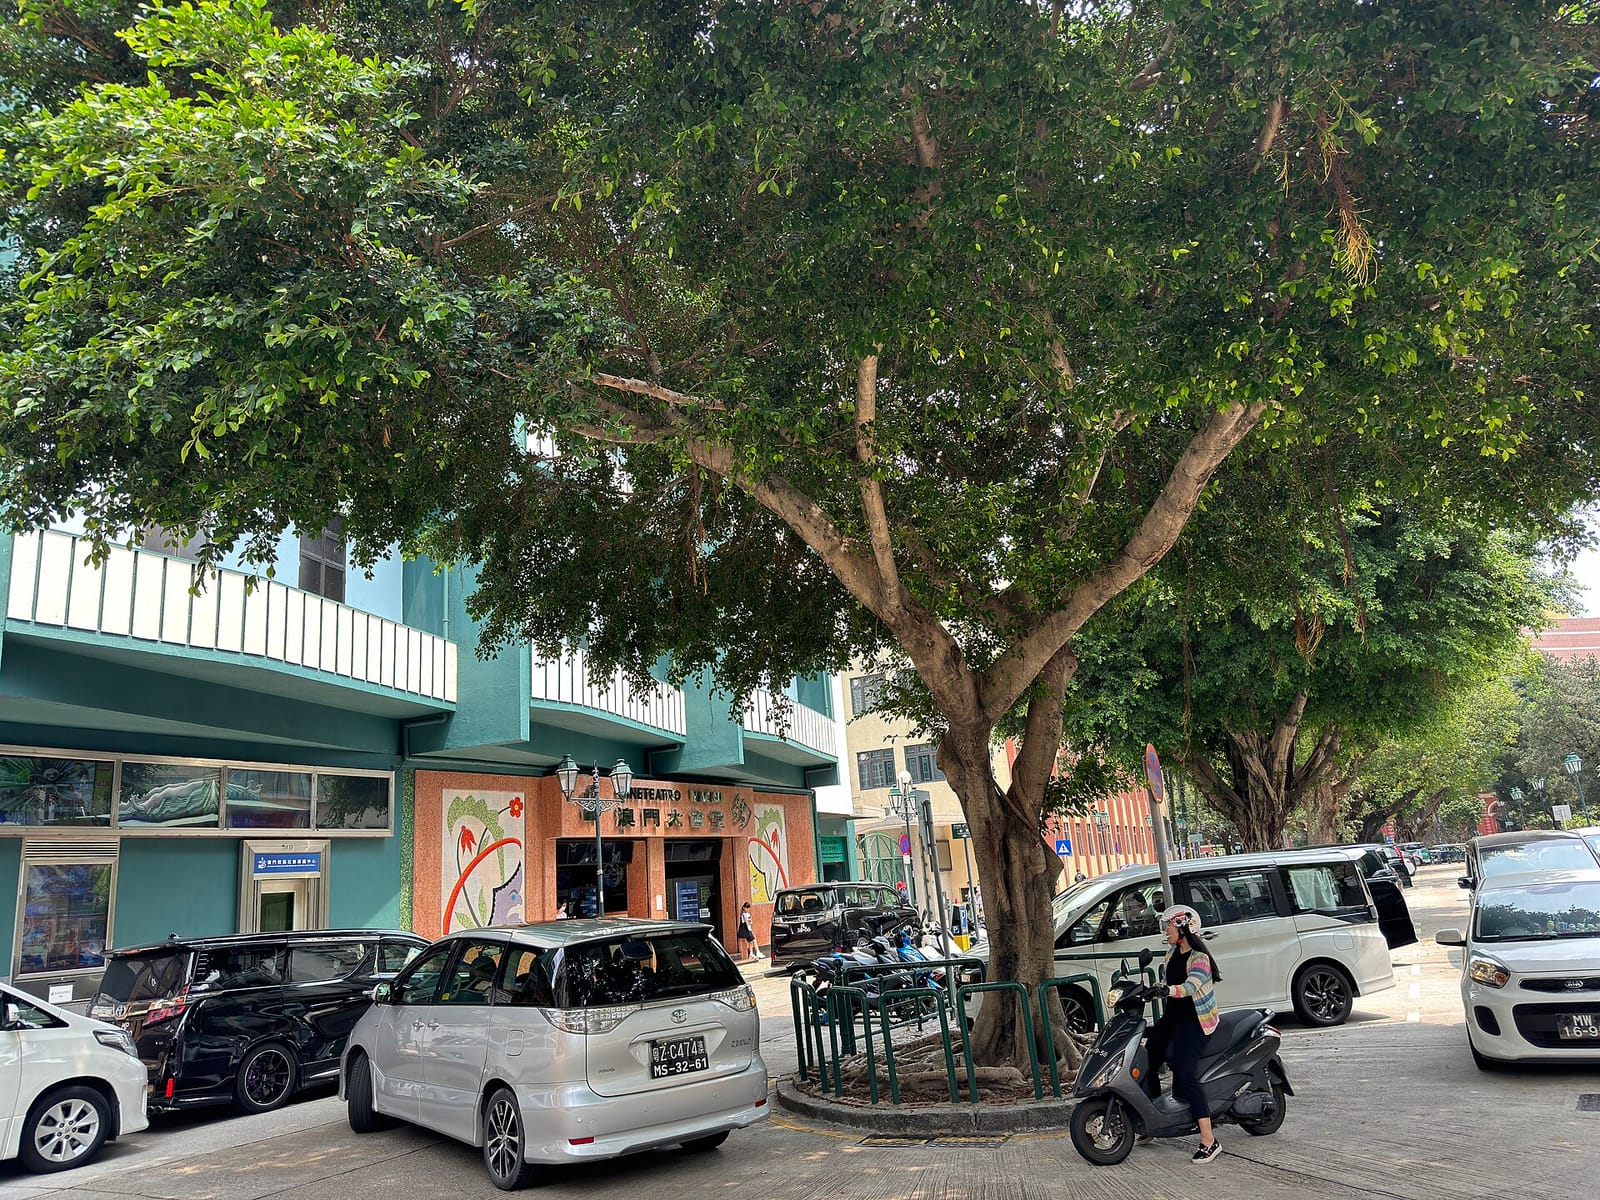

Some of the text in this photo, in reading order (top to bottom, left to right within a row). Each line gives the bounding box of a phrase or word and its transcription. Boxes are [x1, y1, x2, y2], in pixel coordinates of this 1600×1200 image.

[1572, 1014, 1592, 1026] MW
[1564, 1025, 1600, 1037] 16-9
[653, 1057, 707, 1077] MS-32-61
